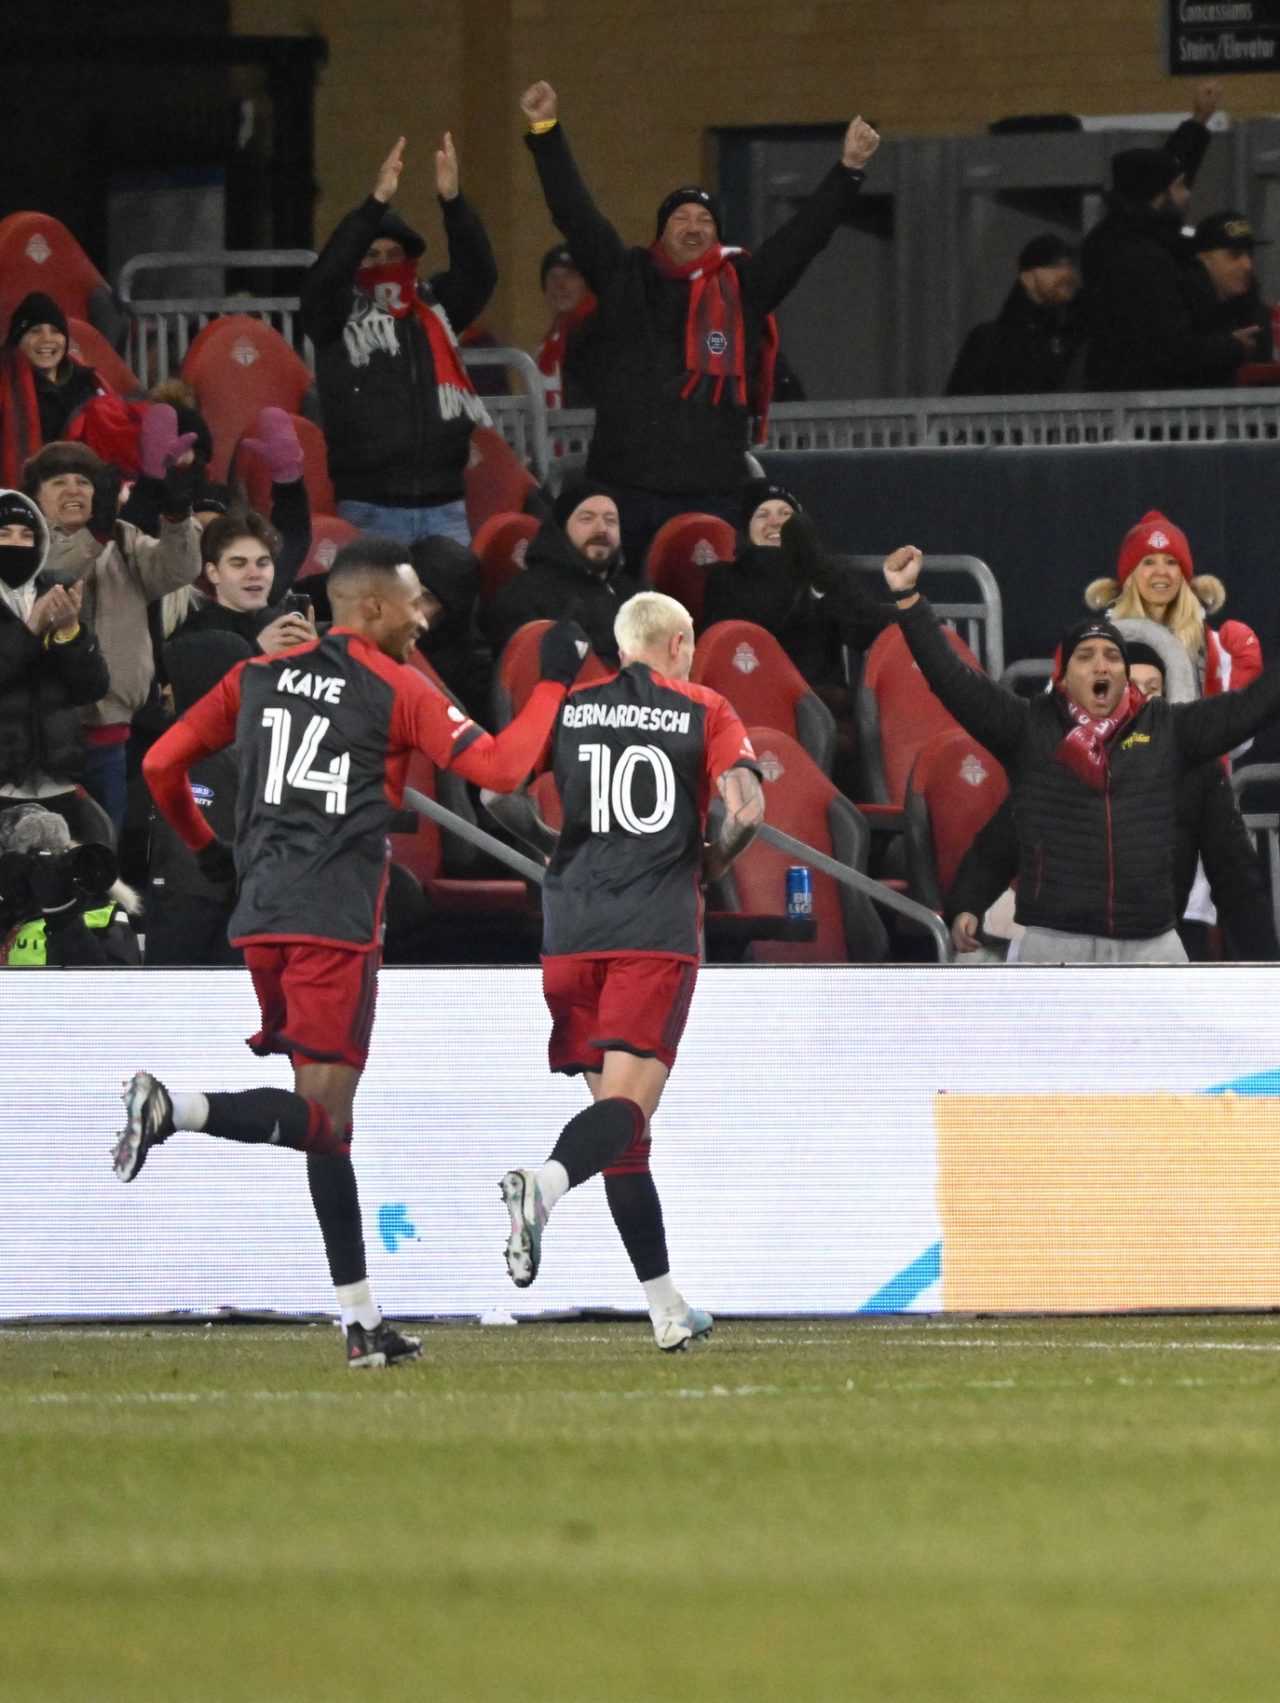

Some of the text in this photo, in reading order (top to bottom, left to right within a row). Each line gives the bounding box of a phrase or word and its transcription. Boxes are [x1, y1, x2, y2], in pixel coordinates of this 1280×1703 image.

[277, 668, 346, 704] KAYE
[562, 703, 691, 734] BERNARDESCHI
[262, 708, 351, 815] 14
[578, 743, 676, 835] 10
